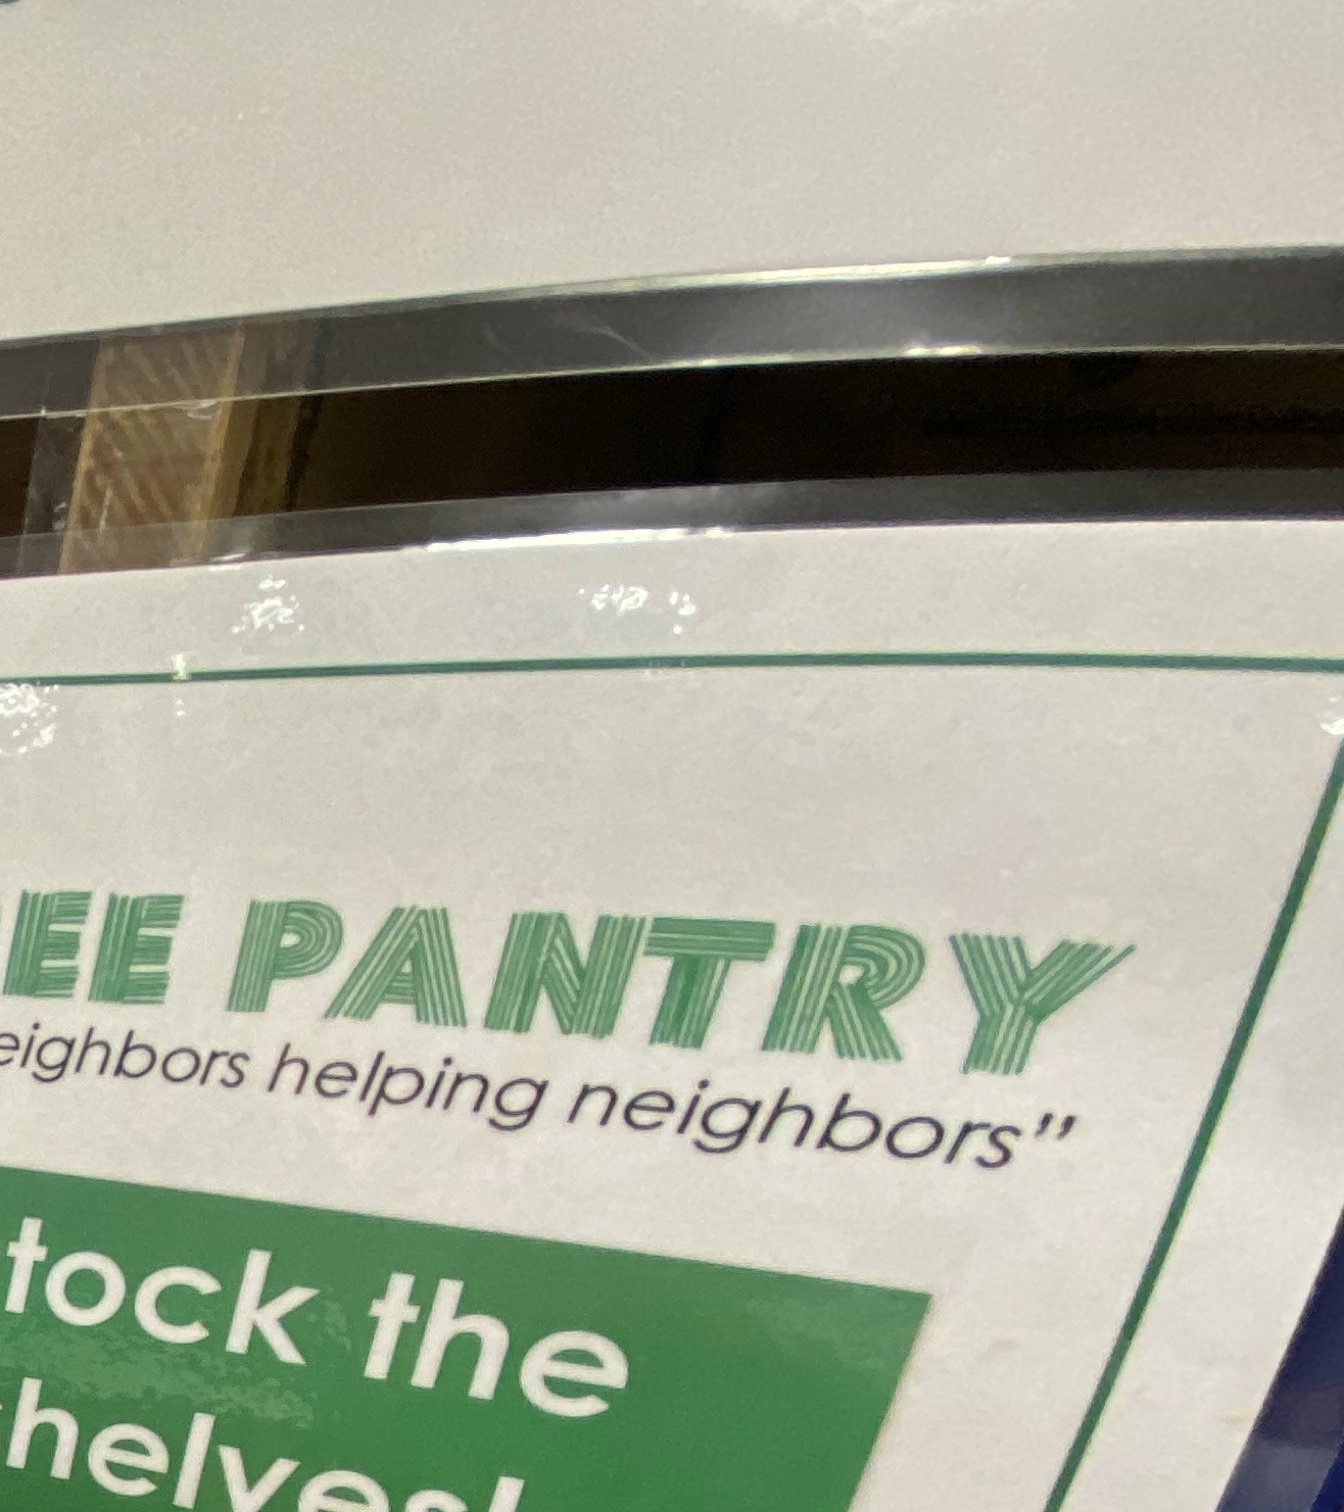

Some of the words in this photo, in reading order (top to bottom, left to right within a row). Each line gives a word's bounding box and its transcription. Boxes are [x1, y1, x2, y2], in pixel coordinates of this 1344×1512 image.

[227, 900, 1136, 1078] PANTRY
[270, 1043, 542, 1138] helping
[569, 1066, 1079, 1174] neighbors"
[365, 1271, 631, 1420] the
